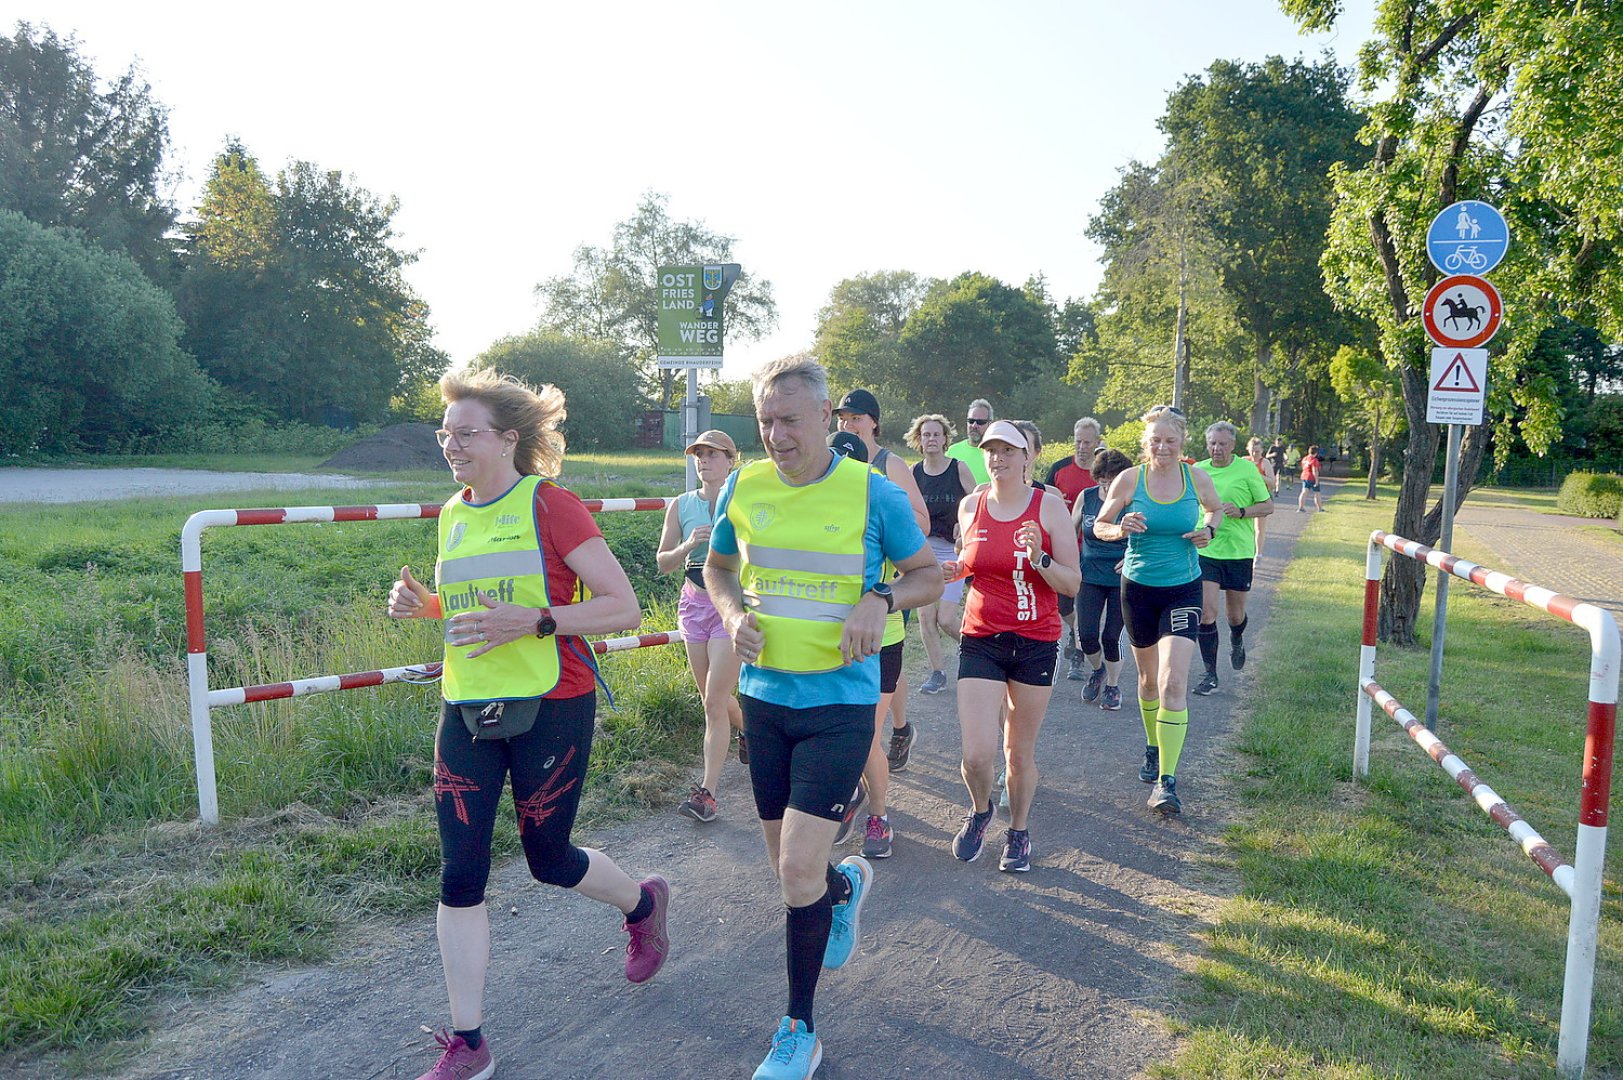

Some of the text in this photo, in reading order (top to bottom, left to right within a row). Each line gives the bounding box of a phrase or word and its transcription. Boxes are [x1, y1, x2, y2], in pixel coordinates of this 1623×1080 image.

[662, 273, 695, 287] OST
[662, 289, 695, 298] FRIES
[662, 300, 695, 309] LAND
[680, 330, 718, 343] WEG
[1017, 611, 1031, 621] 07
